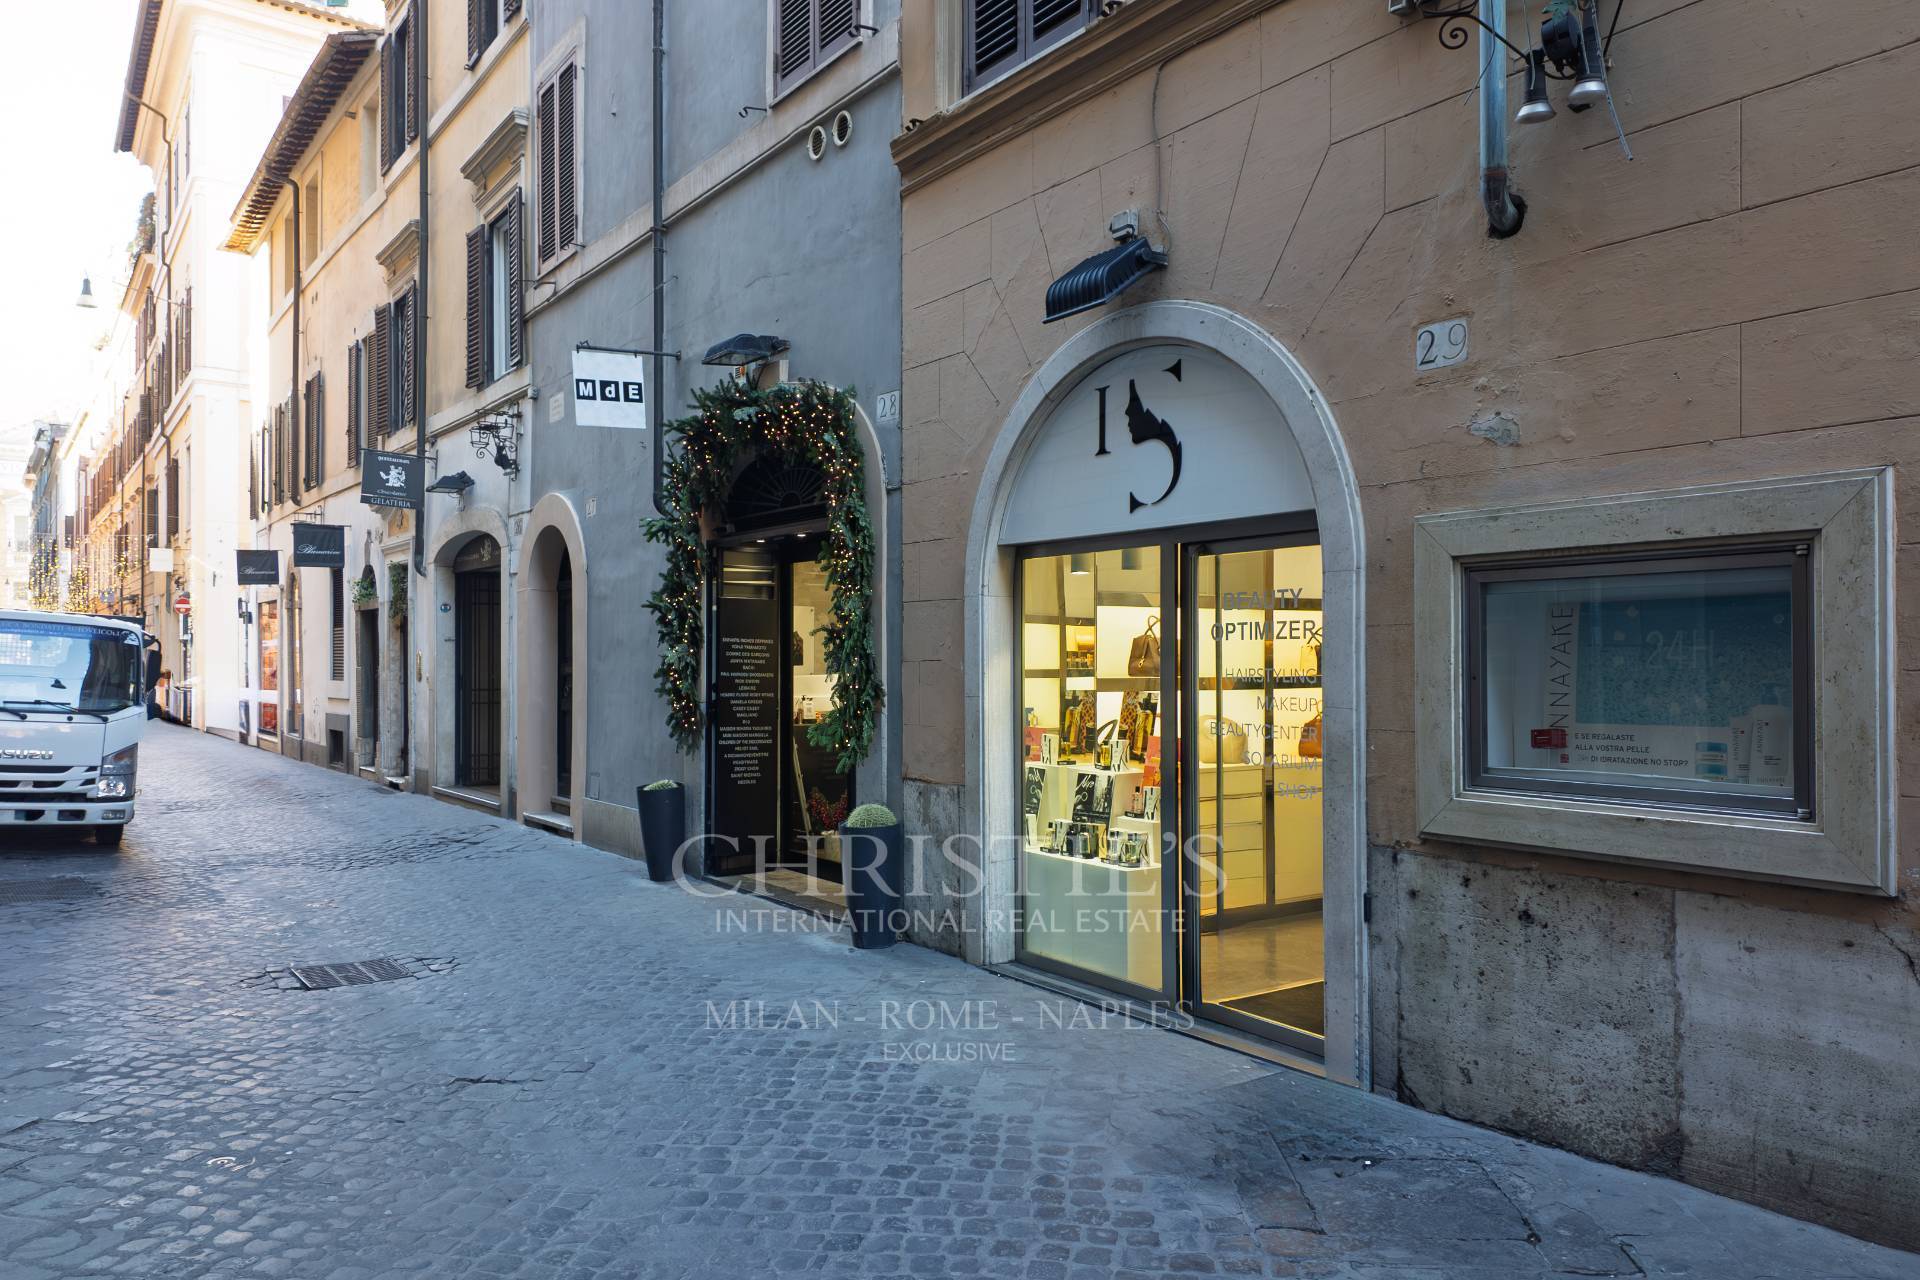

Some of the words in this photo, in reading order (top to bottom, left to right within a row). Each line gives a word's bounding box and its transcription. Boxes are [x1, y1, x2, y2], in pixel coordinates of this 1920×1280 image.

[1417, 323, 1467, 366] 29
[578, 381, 640, 400] MdE
[879, 394, 897, 418] 28
[1222, 588, 1303, 610] BEAUTY
[1210, 620, 1317, 641] OPTIMIZER
[1225, 668, 1317, 685] HAIRSTYLING
[1549, 607, 1574, 728] NNAYAKE
[1256, 696, 1318, 712] MAKEUP
[1210, 722, 1318, 741] BEAUTYCENTER
[1243, 751, 1318, 771] SOLARIUM
[1650, 758, 1662, 766] NO
[1664, 759, 1689, 768] STOP?
[1277, 782, 1318, 800] SHOP
